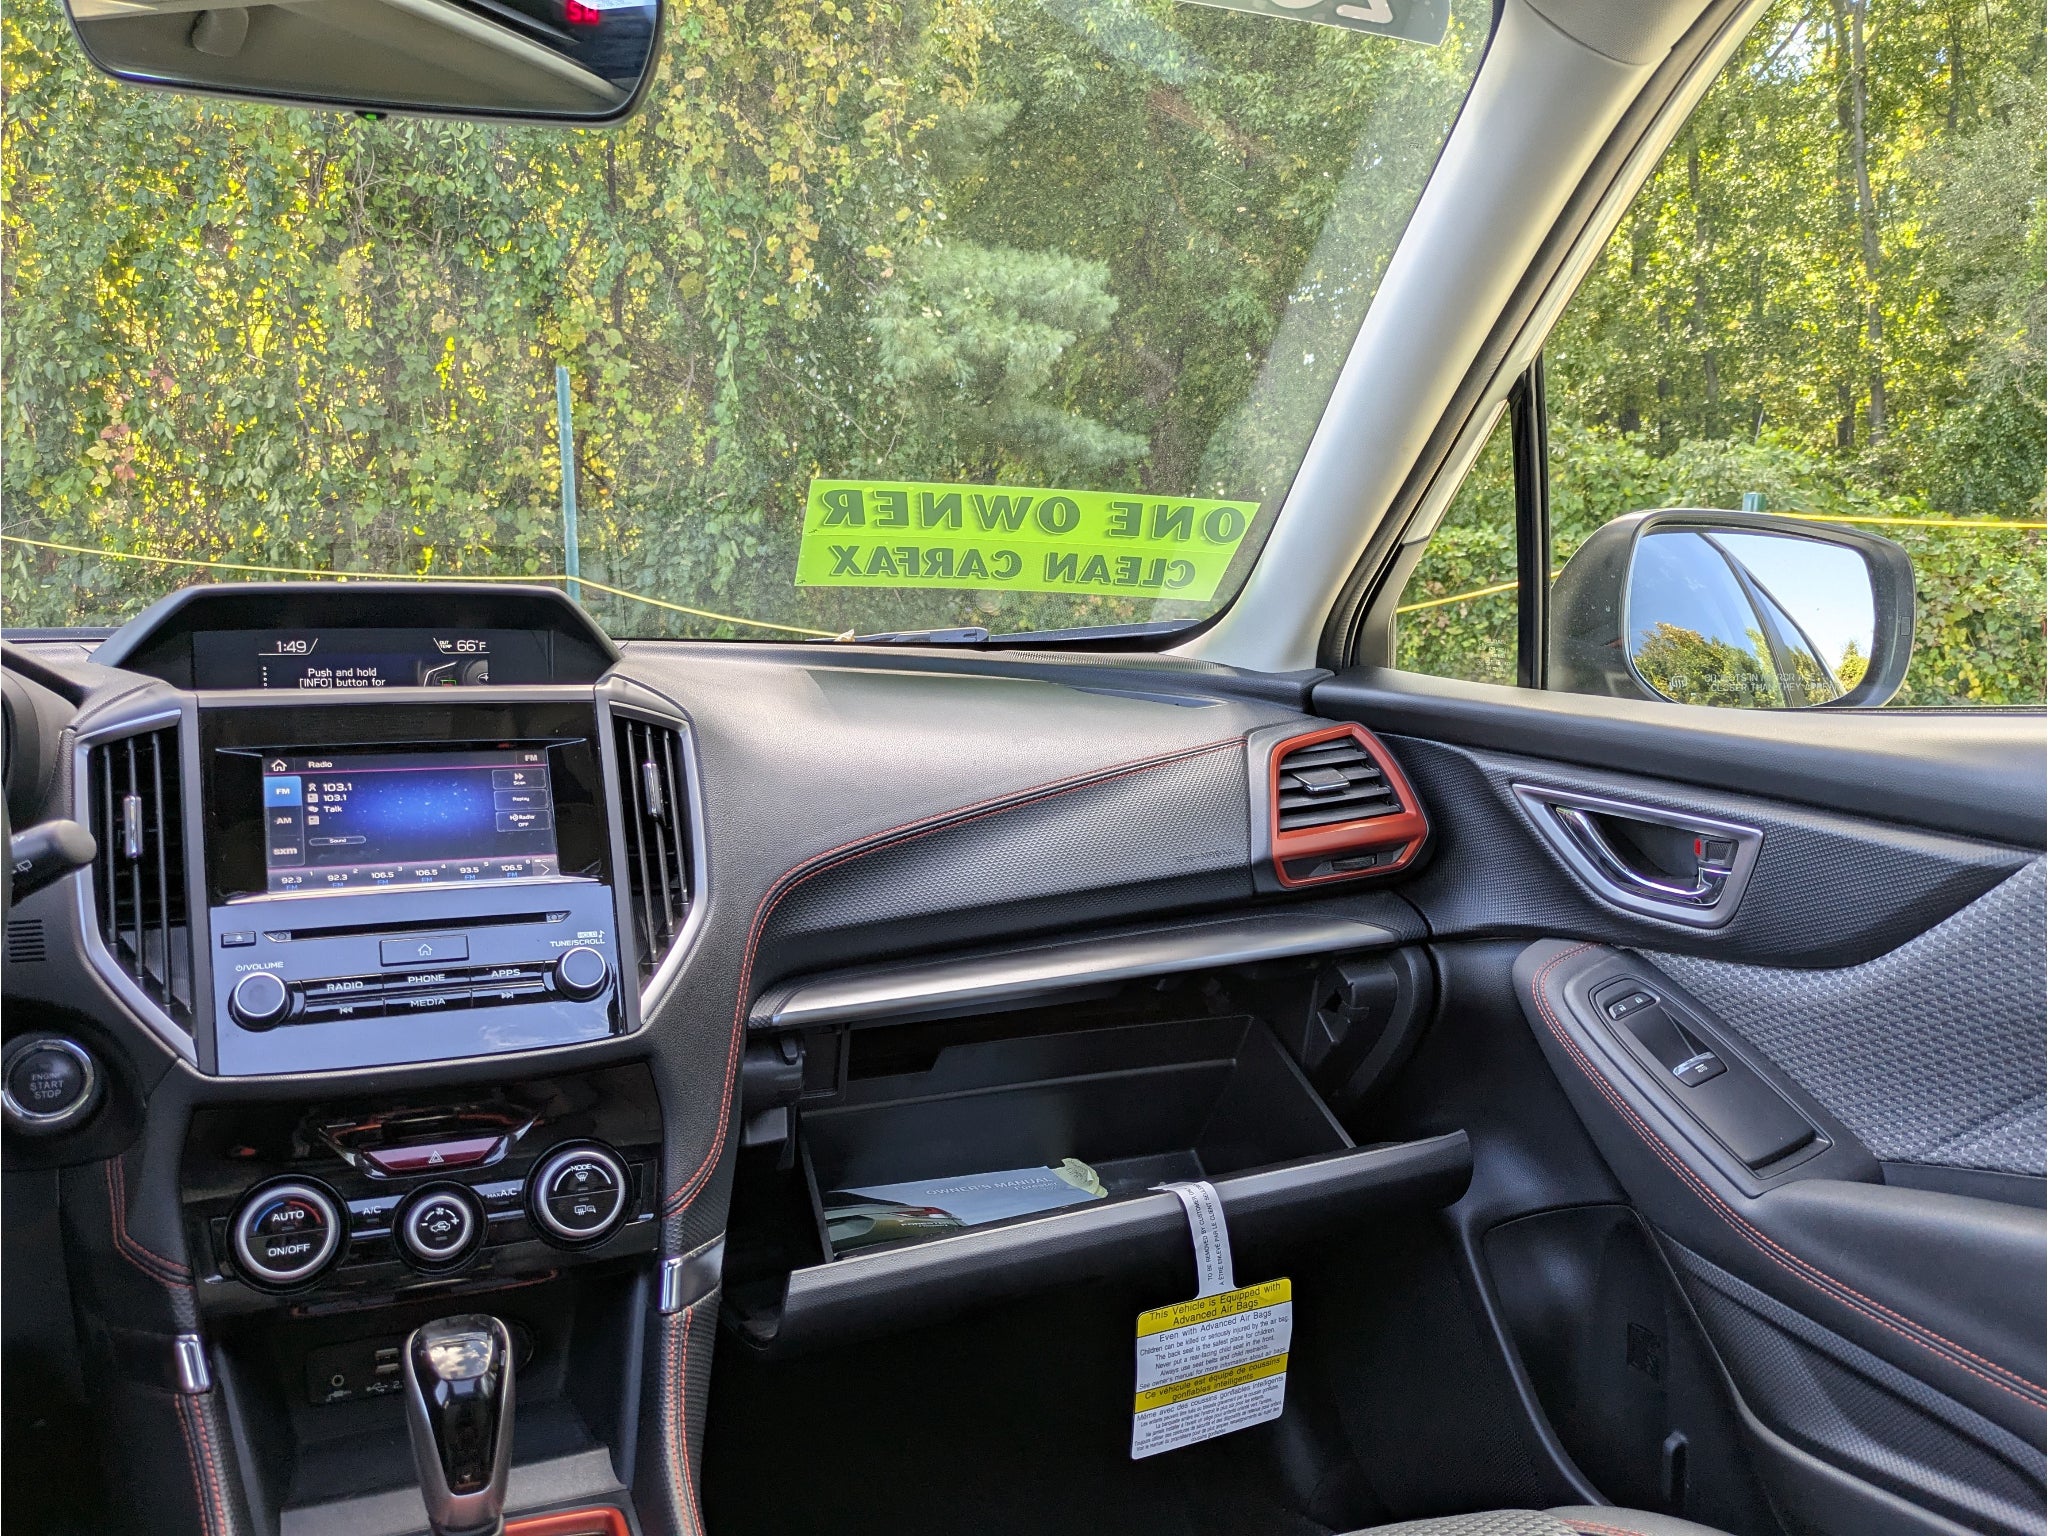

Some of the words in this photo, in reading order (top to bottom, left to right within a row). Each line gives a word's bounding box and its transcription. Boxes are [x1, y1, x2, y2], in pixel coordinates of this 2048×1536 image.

[276, 640, 307, 653] 1:49
[307, 668, 332, 677] Push
[336, 668, 353, 677] and
[356, 667, 377, 677] hold
[299, 678, 333, 689] [INFO]
[336, 678, 368, 687] button
[371, 678, 386, 686] for
[1711, 683, 1748, 692] CLOSER
[1751, 682, 1774, 692] THA
[1778, 682, 1801, 692] HEY
[524, 754, 538, 762] FM
[322, 783, 352, 792] 103.1
[323, 794, 347, 802] 103.1
[323, 805, 343, 813] Talk
[371, 871, 395, 879] 106.5
[459, 866, 480, 874] 93.5
[327, 874, 348, 882] 92.3
[550, 938, 606, 947] TUNE/SCROLL
[407, 973, 446, 984] PHONE
[491, 968, 521, 979] APPS
[327, 981, 364, 992] RADIO
[410, 998, 446, 1008] MEDIA
[30, 1080, 65, 1092] START
[34, 1089, 62, 1100] STOP
[570, 1164, 592, 1172] MODE
[500, 1187, 518, 1197] A/C
[272, 1209, 305, 1222] AUTO
[363, 1206, 381, 1216] A/C
[1192, 1196, 1205, 1225] CUSTOMER
[1207, 1202, 1215, 1220] CLIENT
[268, 1243, 311, 1257] ON/OFF
[1203, 1236, 1211, 1262] REMOVED
[1150, 1310, 1168, 1321] This
[1174, 1301, 1205, 1316] Vehicle
[1220, 1287, 1261, 1306] Equipped
[1264, 1282, 1281, 1294] with
[1173, 1308, 1217, 1327] Advanced
[1221, 1304, 1233, 1315] Air
[1236, 1298, 1259, 1313] Bags
[1160, 1331, 1178, 1342] Even
[1182, 1326, 1197, 1337] with
[1201, 1316, 1237, 1333] Advanced
[1240, 1313, 1251, 1323] Air
[1253, 1308, 1272, 1321] Bags
